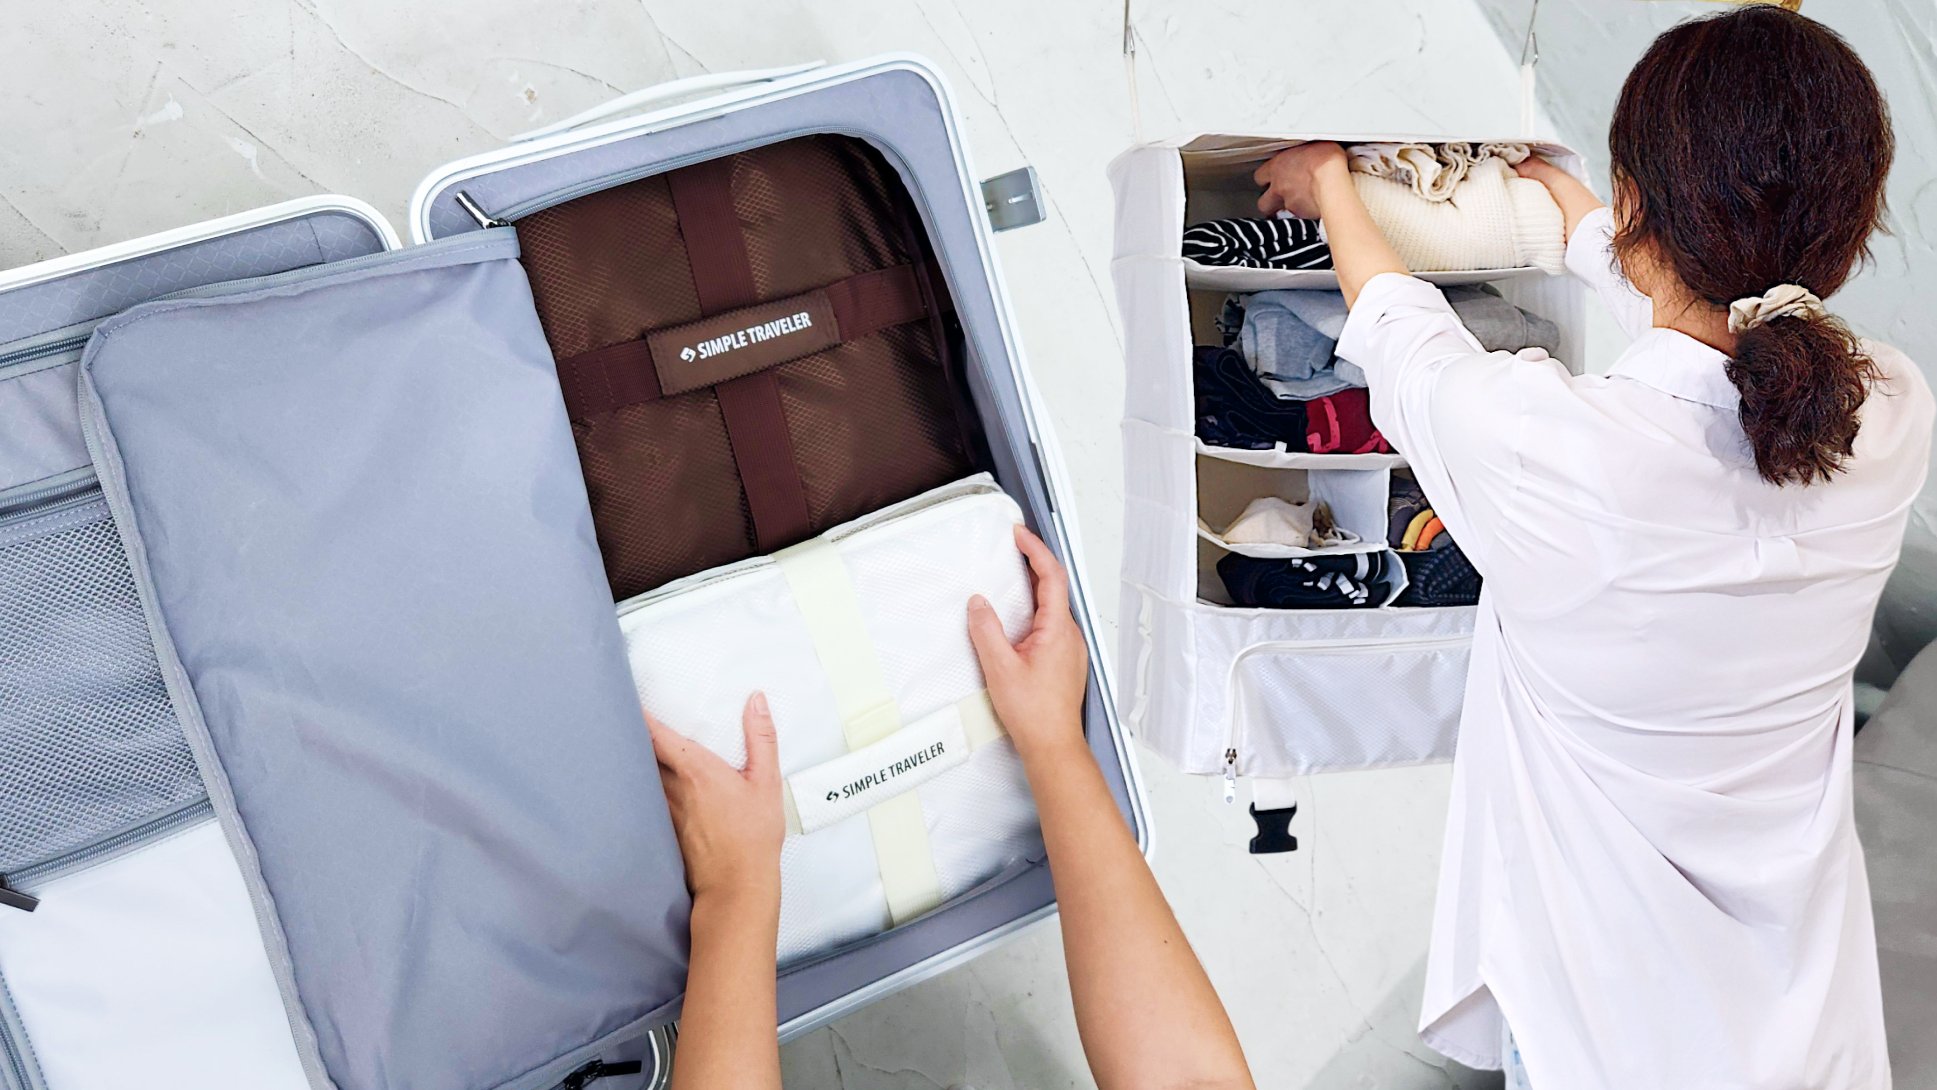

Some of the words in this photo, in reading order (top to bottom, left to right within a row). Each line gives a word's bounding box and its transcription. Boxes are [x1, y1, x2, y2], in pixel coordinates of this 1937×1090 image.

[697, 331, 748, 359] SIMPLE
[746, 312, 812, 344] TRAVELER
[842, 769, 887, 799] SIMPLE
[888, 741, 945, 777] TRAVELER
